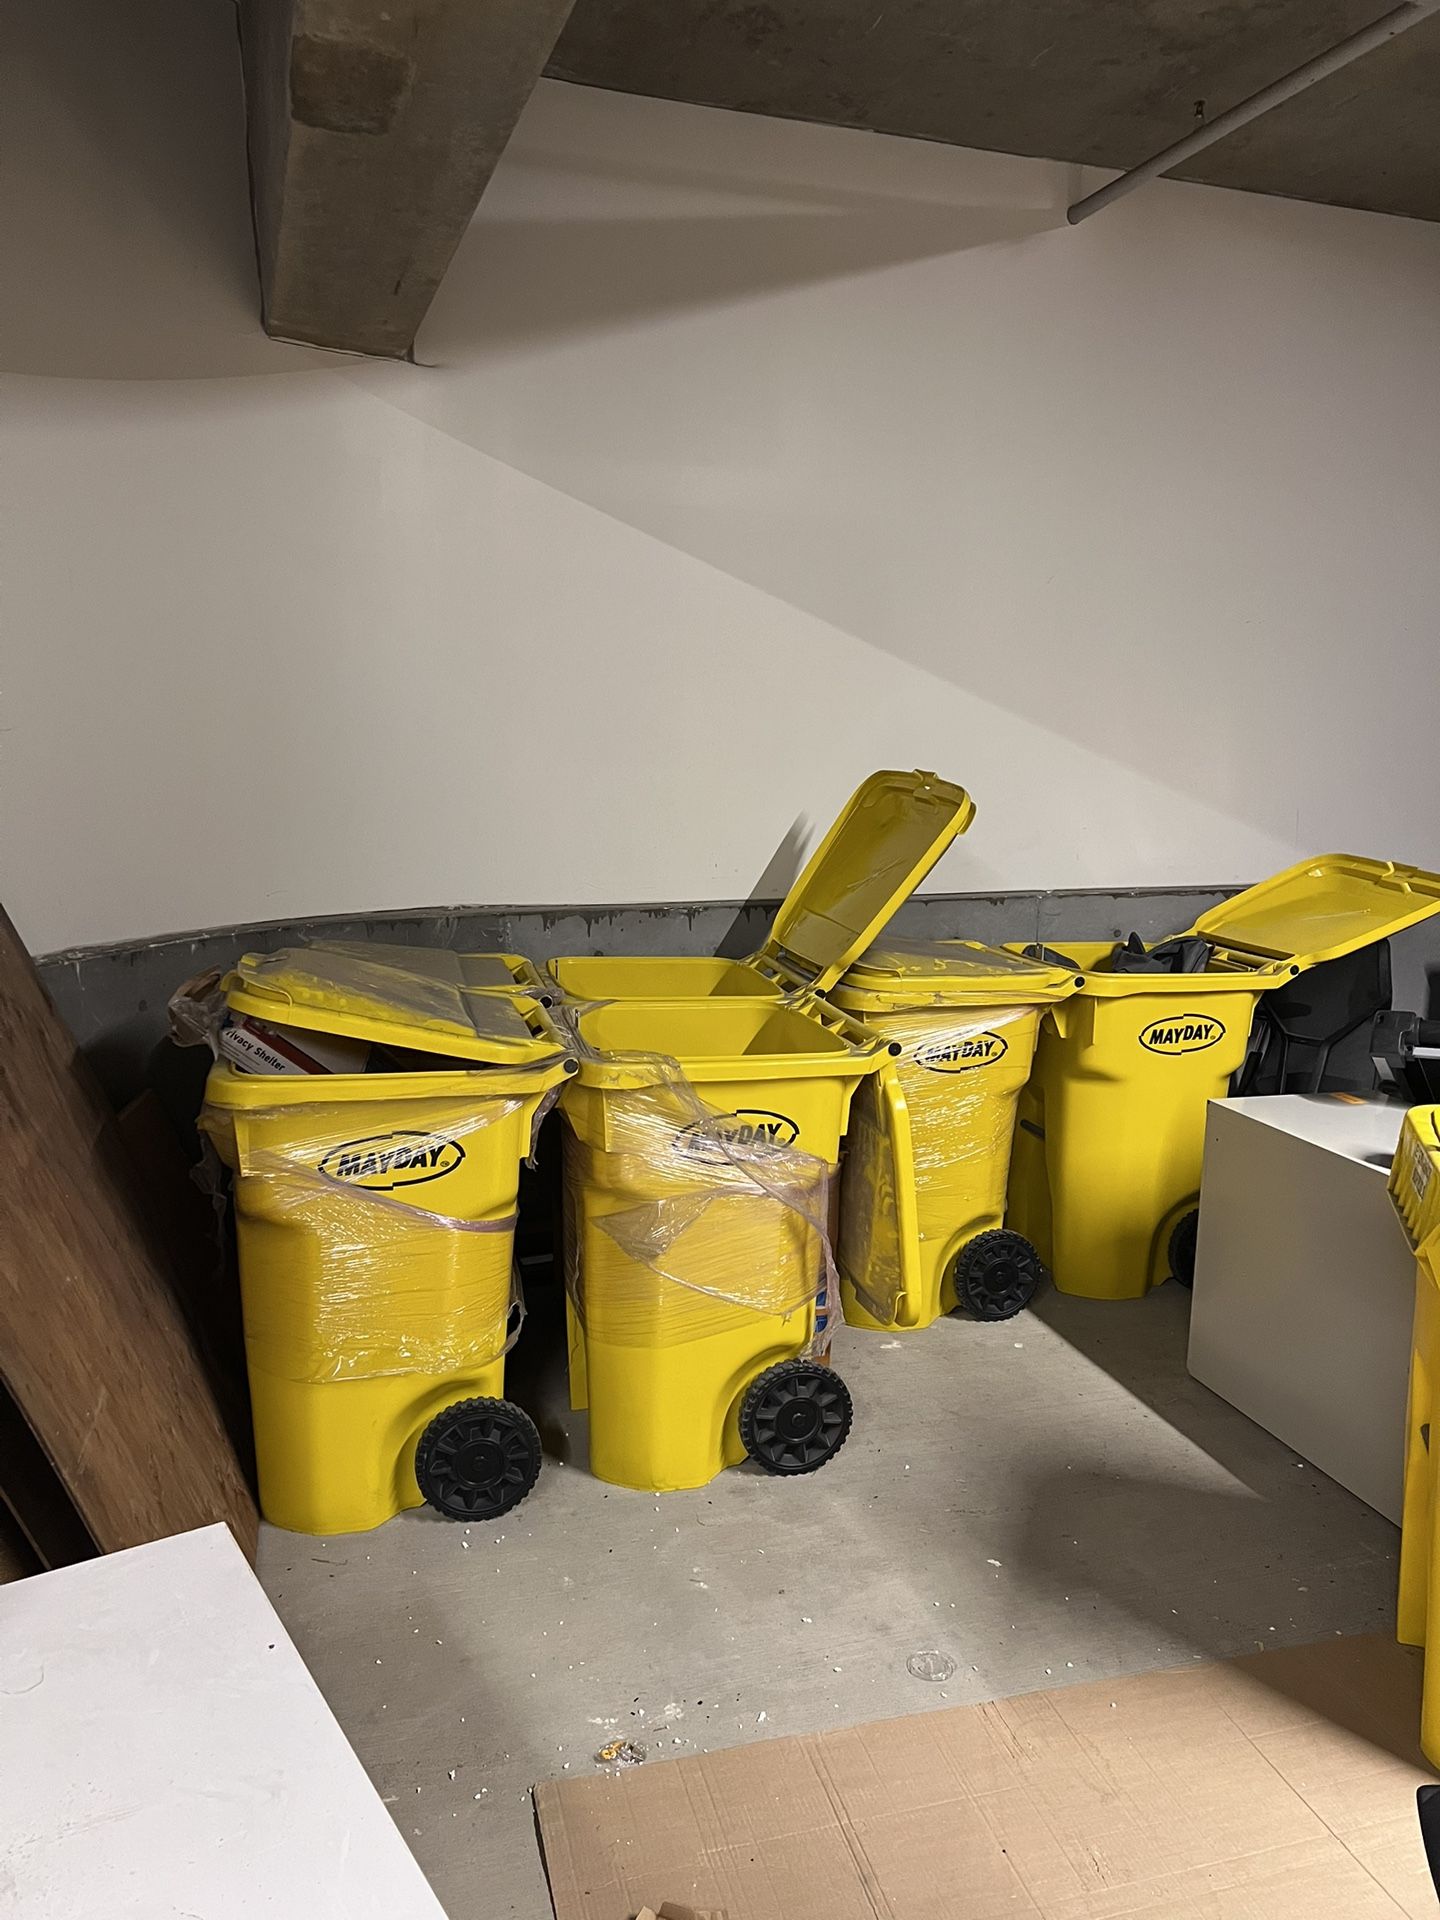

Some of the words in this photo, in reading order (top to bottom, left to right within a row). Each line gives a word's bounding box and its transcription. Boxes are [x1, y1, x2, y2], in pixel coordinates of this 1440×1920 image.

[1149, 1024, 1214, 1044] MAYDAY
[224, 1030, 254, 1051] rivacy
[254, 1047, 286, 1071] Shelter
